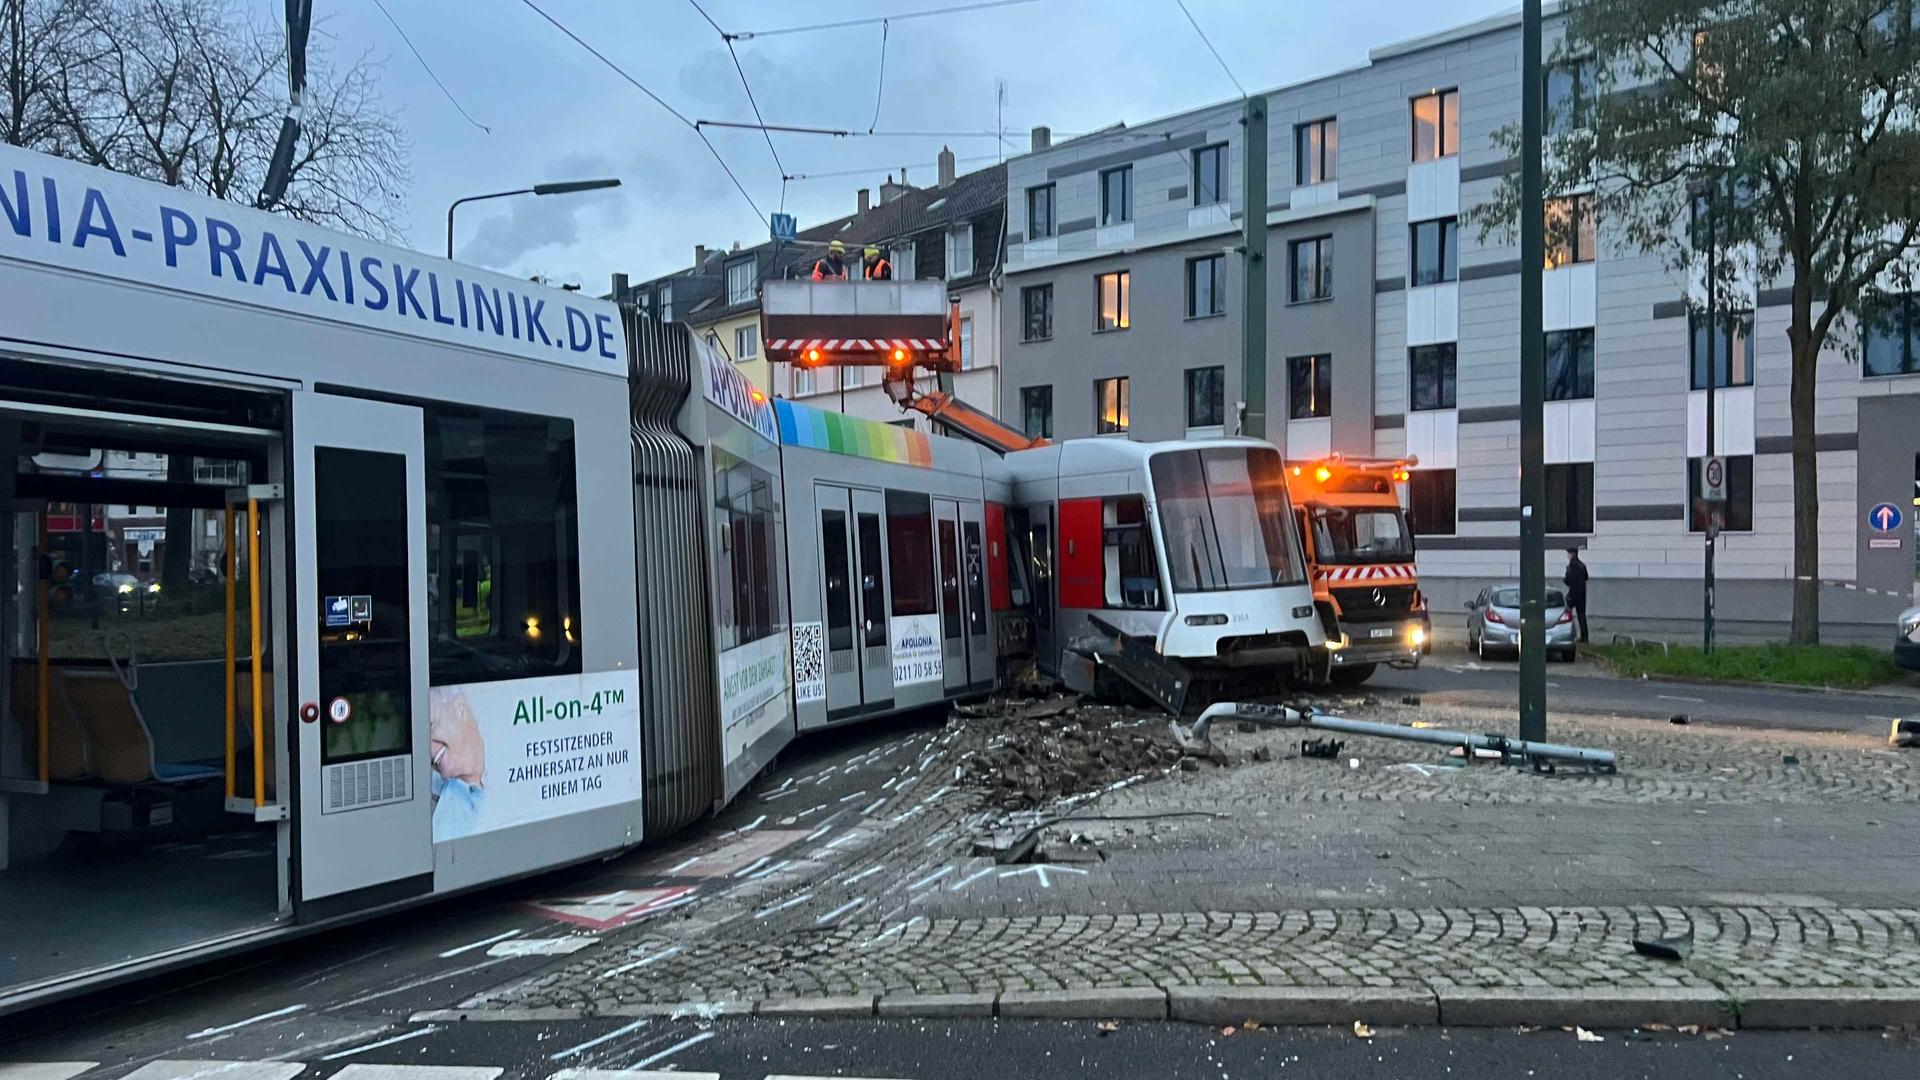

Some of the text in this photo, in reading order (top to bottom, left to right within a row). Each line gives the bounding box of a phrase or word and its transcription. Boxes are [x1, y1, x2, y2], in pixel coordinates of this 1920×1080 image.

[772, 215, 795, 236] W
[902, 636, 932, 649] APOLLONIA
[894, 665, 911, 681] 0211
[914, 663, 922, 678] 70
[924, 662, 932, 676] 58
[797, 684, 824, 699] LIKE US!
[526, 731, 613, 758] FESTSITZENDER
[508, 749, 629, 783] ZAHNERSATZ AN NUR
[541, 775, 602, 800] EINEM TAG
